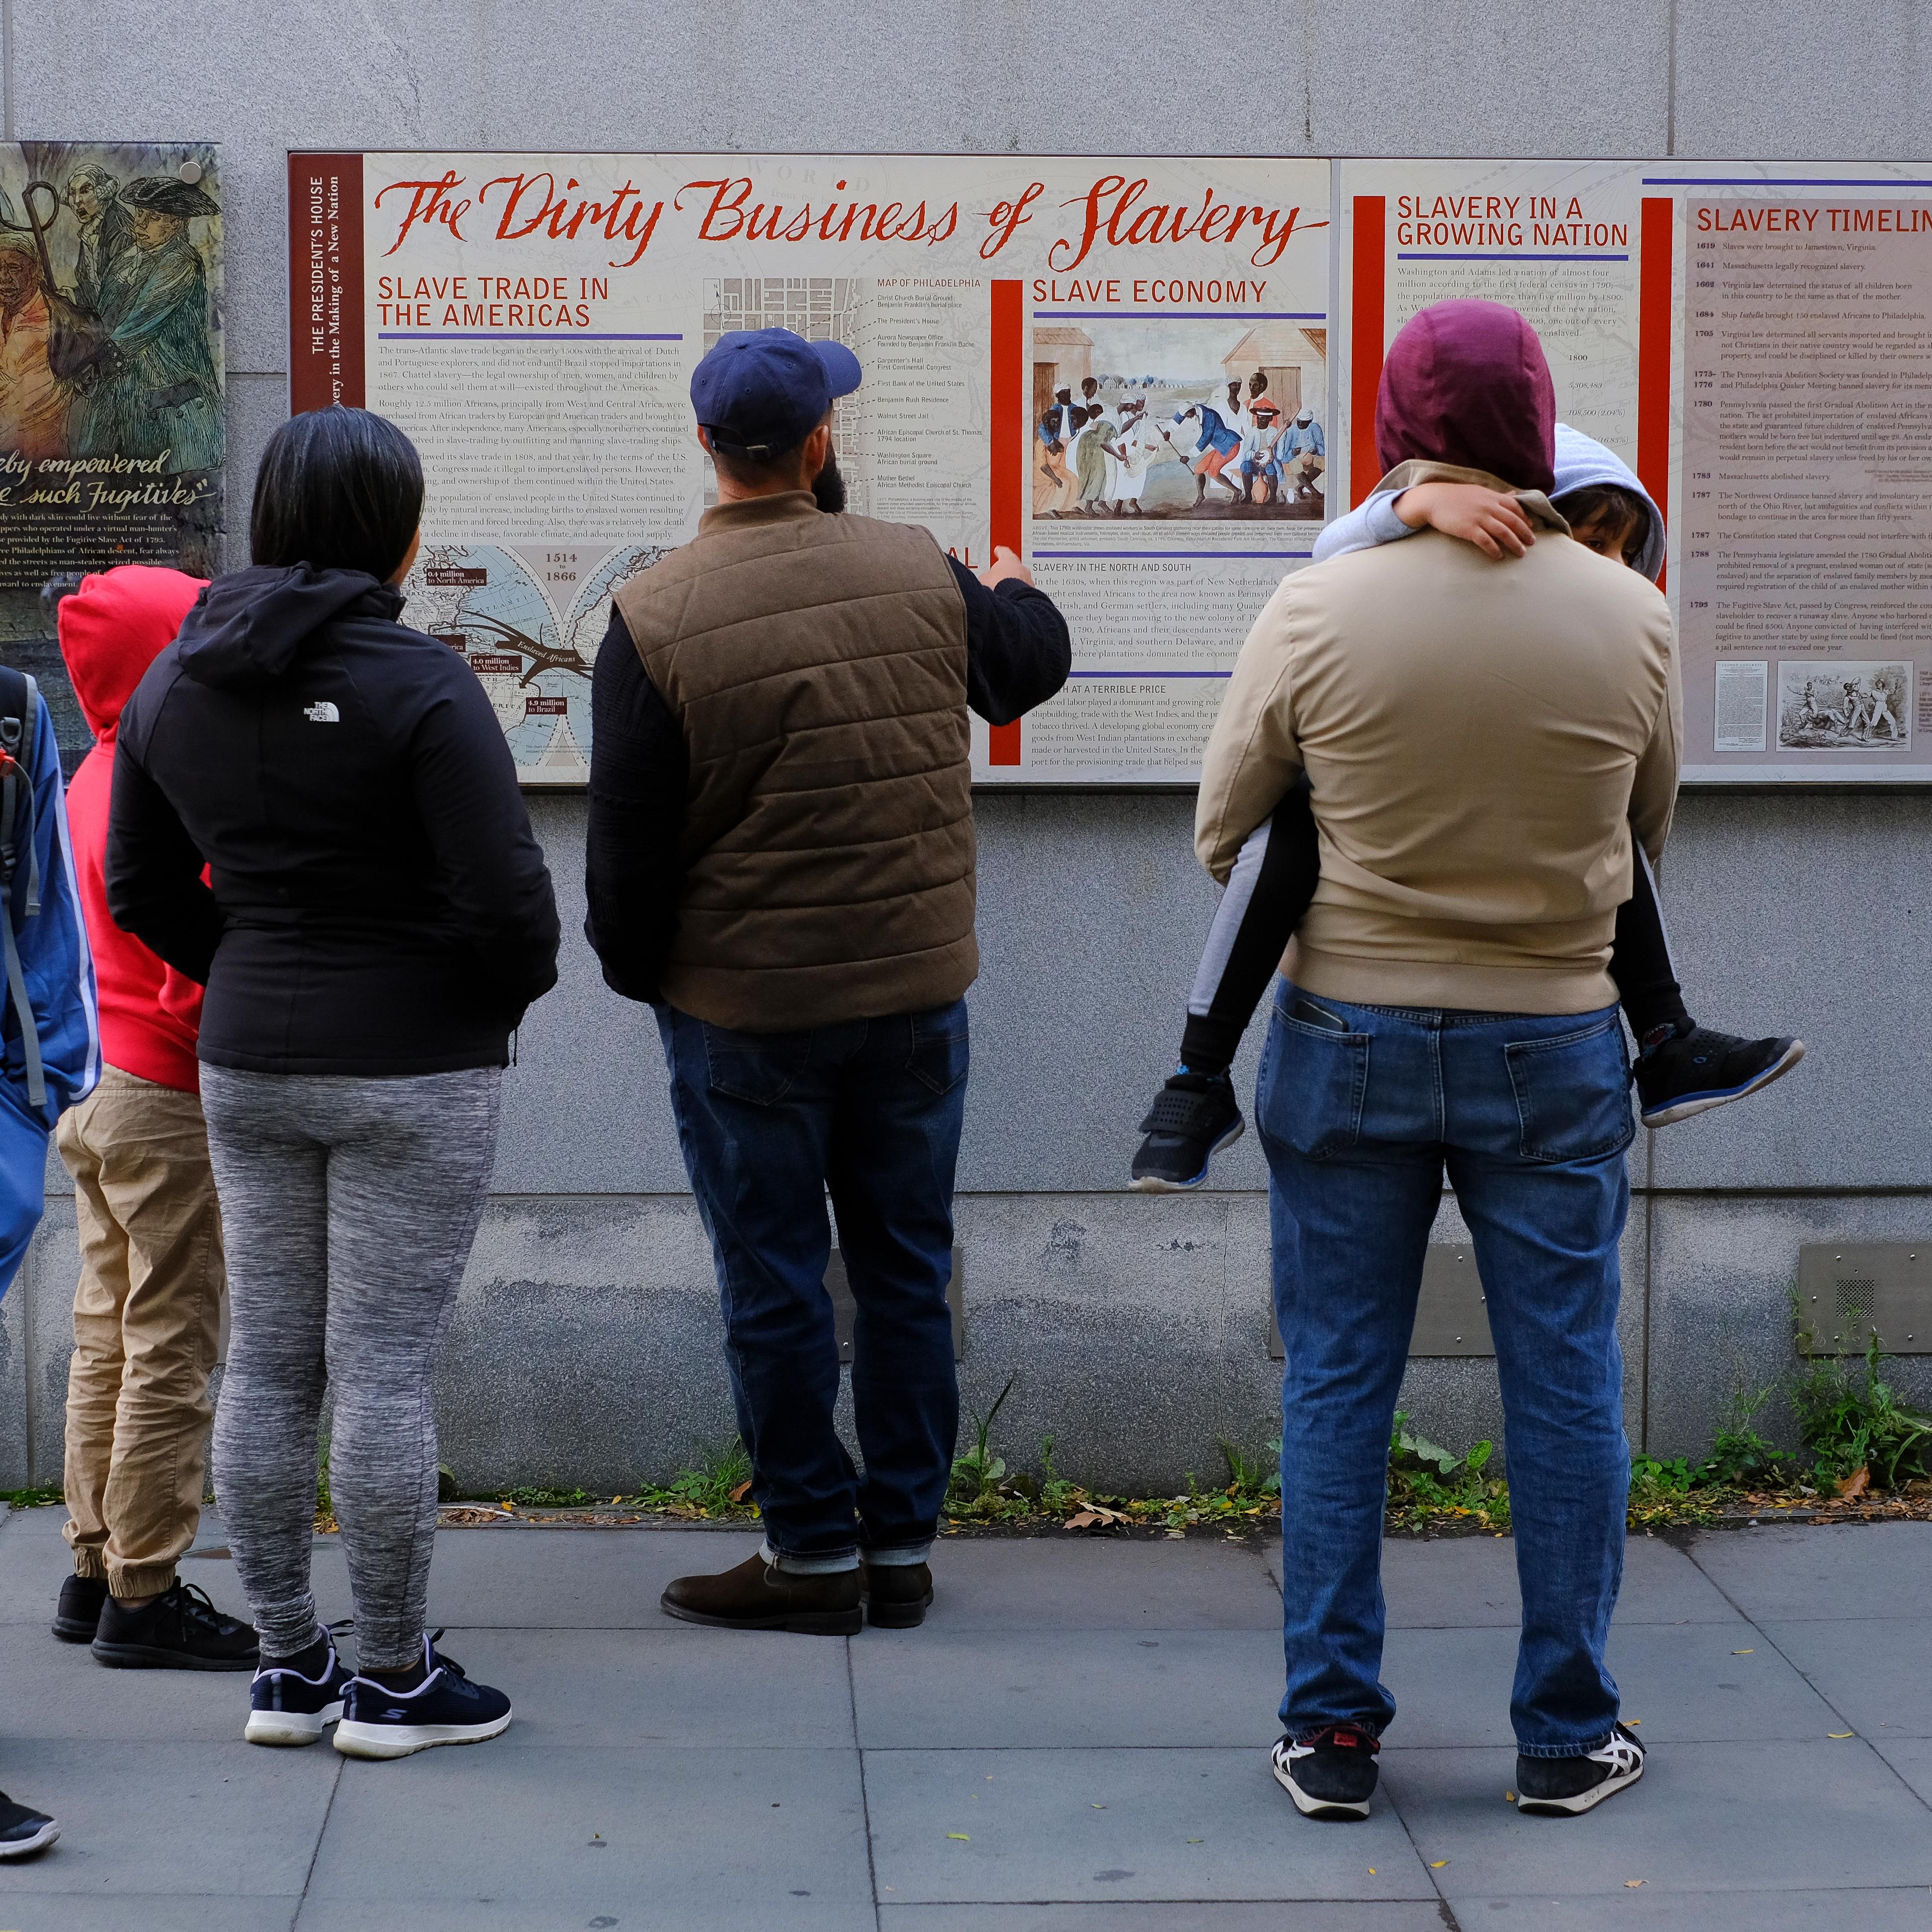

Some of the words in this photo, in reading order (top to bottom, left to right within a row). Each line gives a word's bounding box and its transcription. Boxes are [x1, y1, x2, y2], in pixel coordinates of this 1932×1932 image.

[310, 176, 323, 224] HOUSE
[328, 176, 339, 220] Nation
[1398, 195, 1520, 219] SLAVERY
[1530, 197, 1556, 219] IN
[1565, 197, 1583, 219] A
[374, 170, 471, 257] The
[478, 173, 665, 268] Dirty
[674, 177, 958, 247] Business
[970, 182, 1045, 260] of
[1048, 175, 1330, 273] Slavery
[1697, 208, 1819, 231] SLAVERY
[1826, 209, 1932, 232] TIMELIN
[328, 223, 339, 252] New
[1397, 222, 1522, 246] GROWING
[1534, 223, 1627, 247] NATION
[1764, 243, 1793, 252] brought
[1804, 243, 1844, 251] Jamestown,
[310, 228, 324, 321] PRESIDENT'S
[328, 267, 340, 282] of
[1398, 268, 1447, 278] Washington
[1549, 268, 1559, 276] of
[1723, 262, 1774, 270] Massachusetts
[1775, 262, 1799, 272] legally
[1800, 263, 1838, 272] recognized
[378, 276, 467, 299] SLAVE
[477, 277, 568, 300] TRADE
[580, 277, 608, 300] IN
[877, 279, 898, 287] MAP
[900, 279, 911, 287] OF
[914, 279, 981, 287] PHILADELPHIA
[1032, 279, 1121, 302] SLAVE
[1134, 280, 1267, 303] ECONOMY
[329, 285, 344, 335] Making
[376, 303, 431, 326] THE
[442, 304, 590, 327] AMERICAS
[312, 326, 324, 355] THE
[329, 338, 340, 359] the
[396, 346, 448, 354] trans-Atlantic
[450, 346, 469, 354] slave
[471, 346, 491, 354] trade
[493, 346, 515, 357] began
[526, 346, 538, 354] the
[540, 347, 559, 357] early
[585, 347, 602, 355] with
[604, 347, 616, 355] the
[618, 347, 642, 355] arrival
[330, 362, 341, 375] in
[333, 378, 344, 405] very
[0, 449, 32, 487] eby
[34, 448, 171, 486] empowered
[20, 481, 81, 505] such
[39, 524, 72, 534] operated
[546, 553, 577, 562] 1514
[1032, 563, 1074, 572] SLAVERY
[1077, 564, 1086, 572] IN
[1088, 563, 1106, 572] THE
[1109, 563, 1138, 572] NORTH
[1141, 564, 1160, 572] AND
[1162, 563, 1191, 572] SOUTH
[547, 572, 576, 581] 1866
[517, 640, 548, 658] Enslaved
[546, 654, 576, 663] Africans
[1071, 685, 1082, 693] AT
[1084, 685, 1090, 693] A
[1092, 685, 1137, 694] TERRIBLE
[1140, 685, 1166, 693] PRICE
